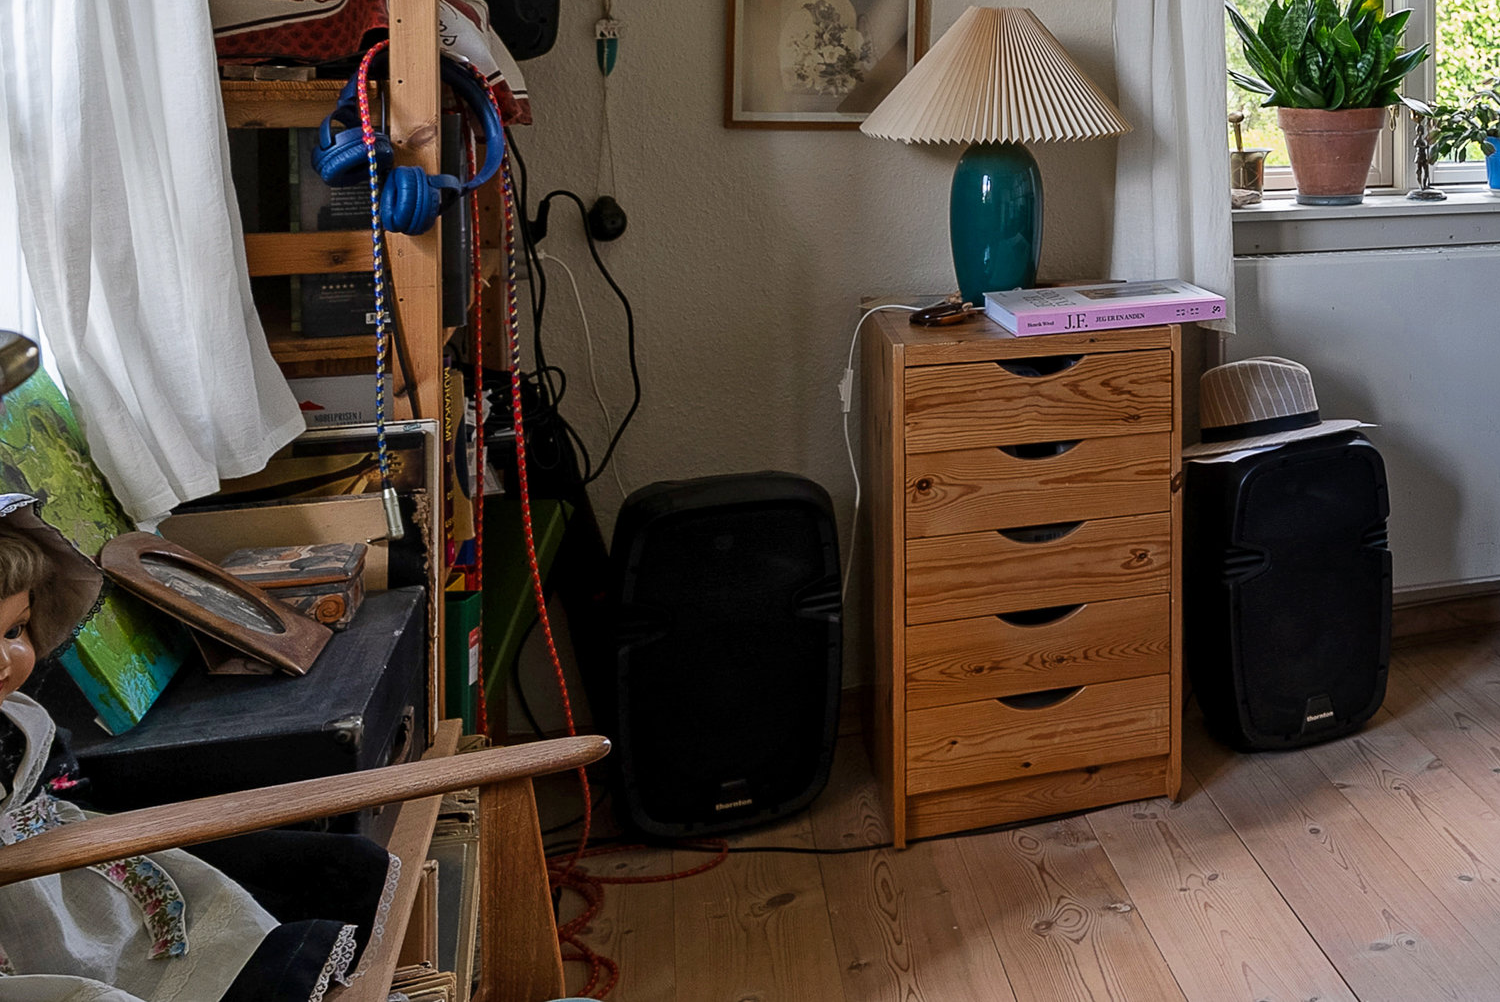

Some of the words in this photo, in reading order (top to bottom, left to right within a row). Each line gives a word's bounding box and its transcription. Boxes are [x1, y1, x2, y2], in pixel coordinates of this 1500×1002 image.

[1064, 313, 1088, 330] J.F.
[1096, 315, 1108, 323] JEG
[1306, 710, 1334, 722] thornton
[714, 798, 754, 812] thornton
